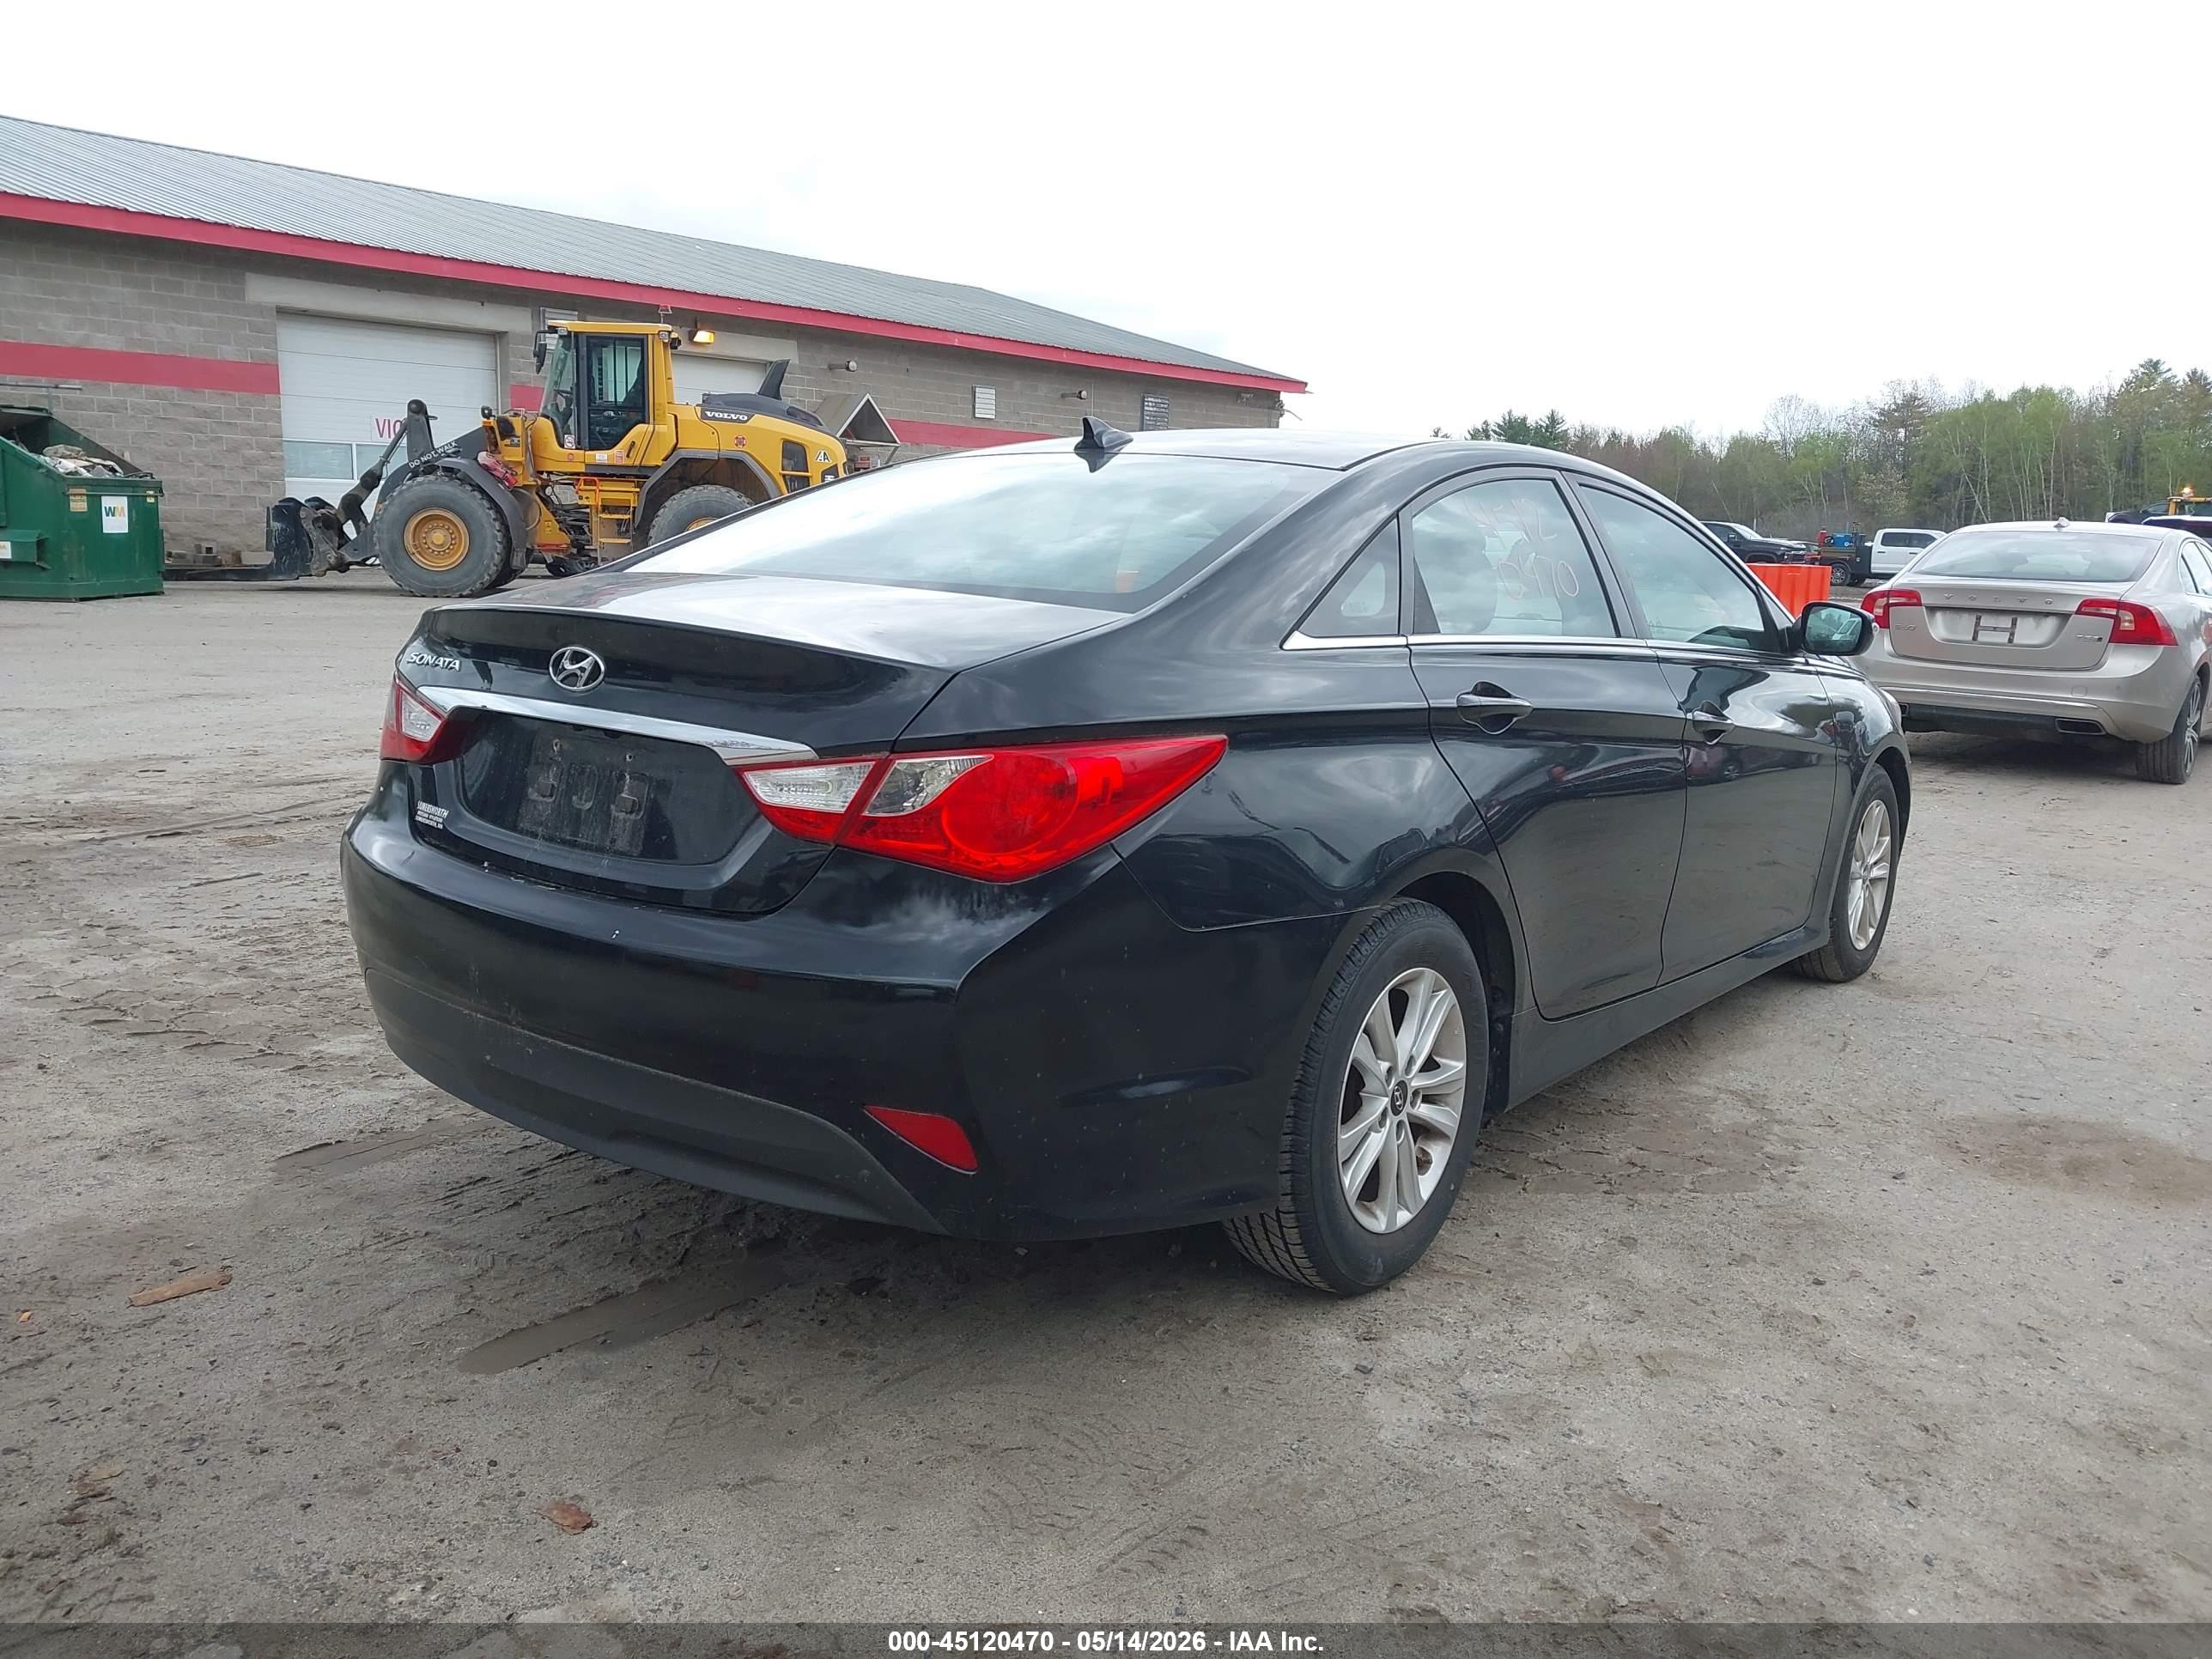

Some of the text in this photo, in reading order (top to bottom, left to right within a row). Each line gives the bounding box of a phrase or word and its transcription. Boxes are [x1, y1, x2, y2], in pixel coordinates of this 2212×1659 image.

[705, 411, 748, 421] VOLVO
[409, 441, 459, 469] DO NOT WALK
[105, 506, 125, 517] WM
[1944, 592, 2054, 605] VOLVO
[406, 653, 460, 672] SONATA
